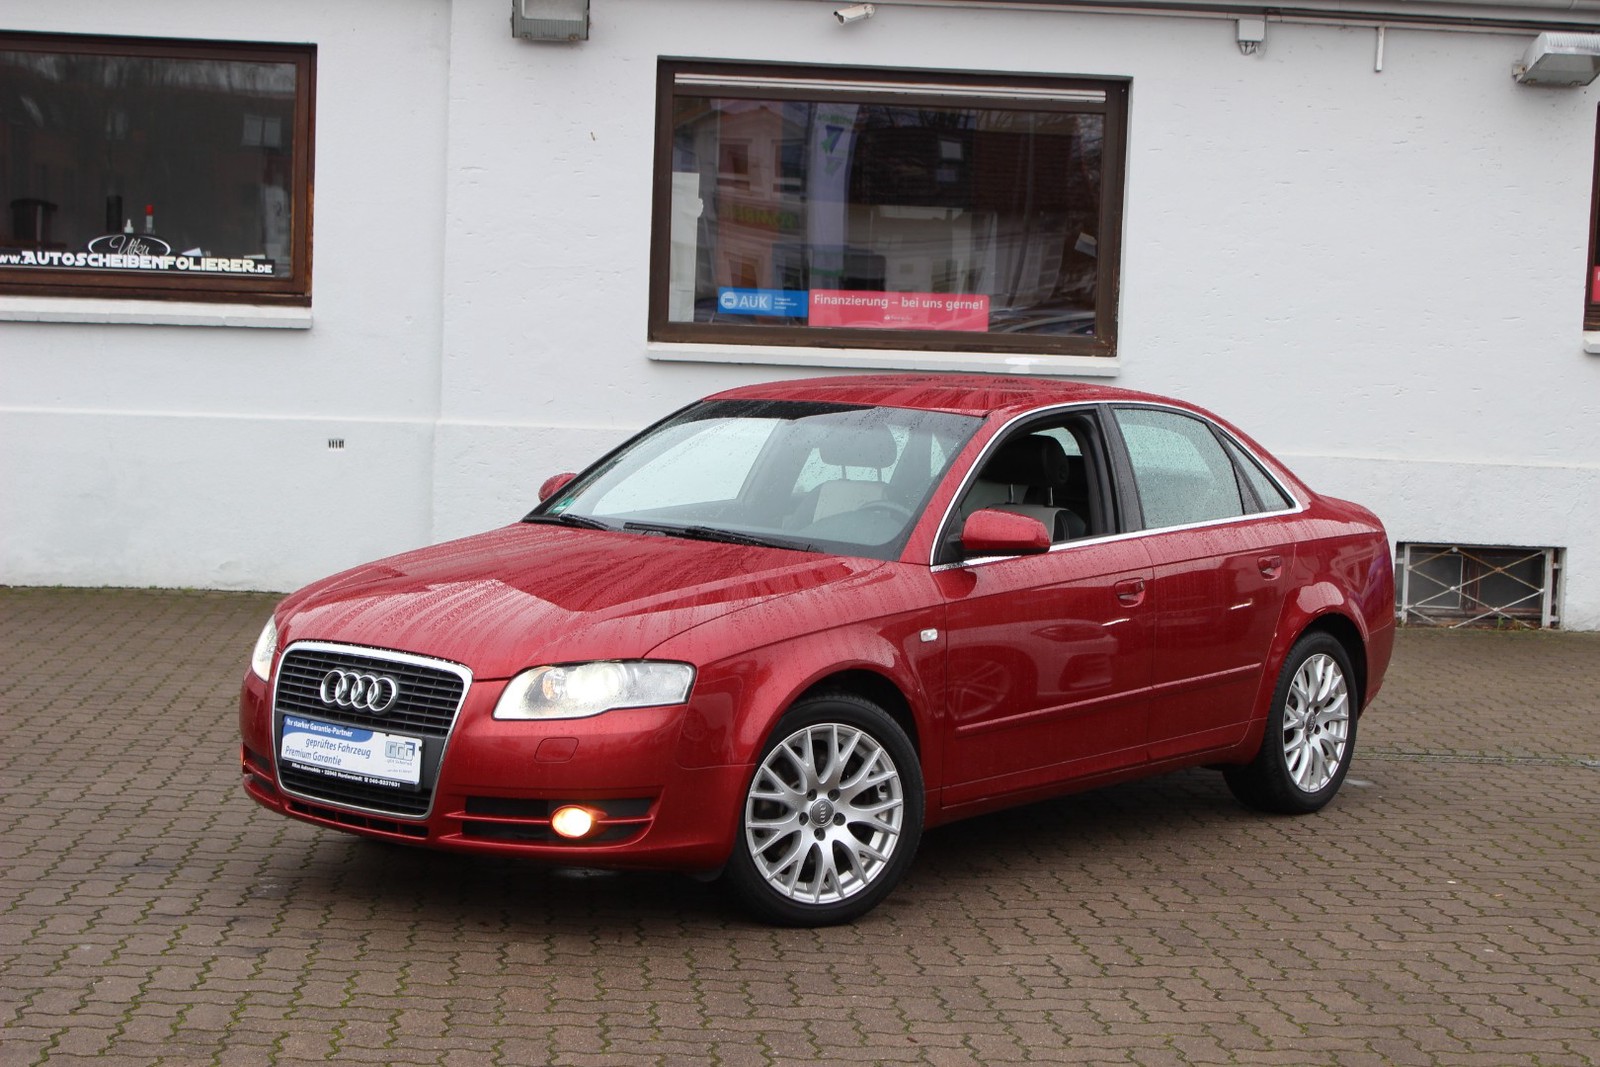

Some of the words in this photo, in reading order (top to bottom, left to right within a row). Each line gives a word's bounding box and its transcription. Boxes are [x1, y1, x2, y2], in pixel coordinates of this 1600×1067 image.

[814, 294, 889, 309] Finanzierung
[901, 297, 920, 308] bei
[922, 299, 943, 309] uns
[945, 299, 983, 311] gerne!
[293, 719, 310, 730] starker
[310, 722, 353, 737] Garantie-Partner
[285, 745, 312, 759] Premium
[312, 751, 342, 765] Garantie
[305, 738, 337, 751] geprüftes
[337, 742, 371, 759] Fahrzeug
